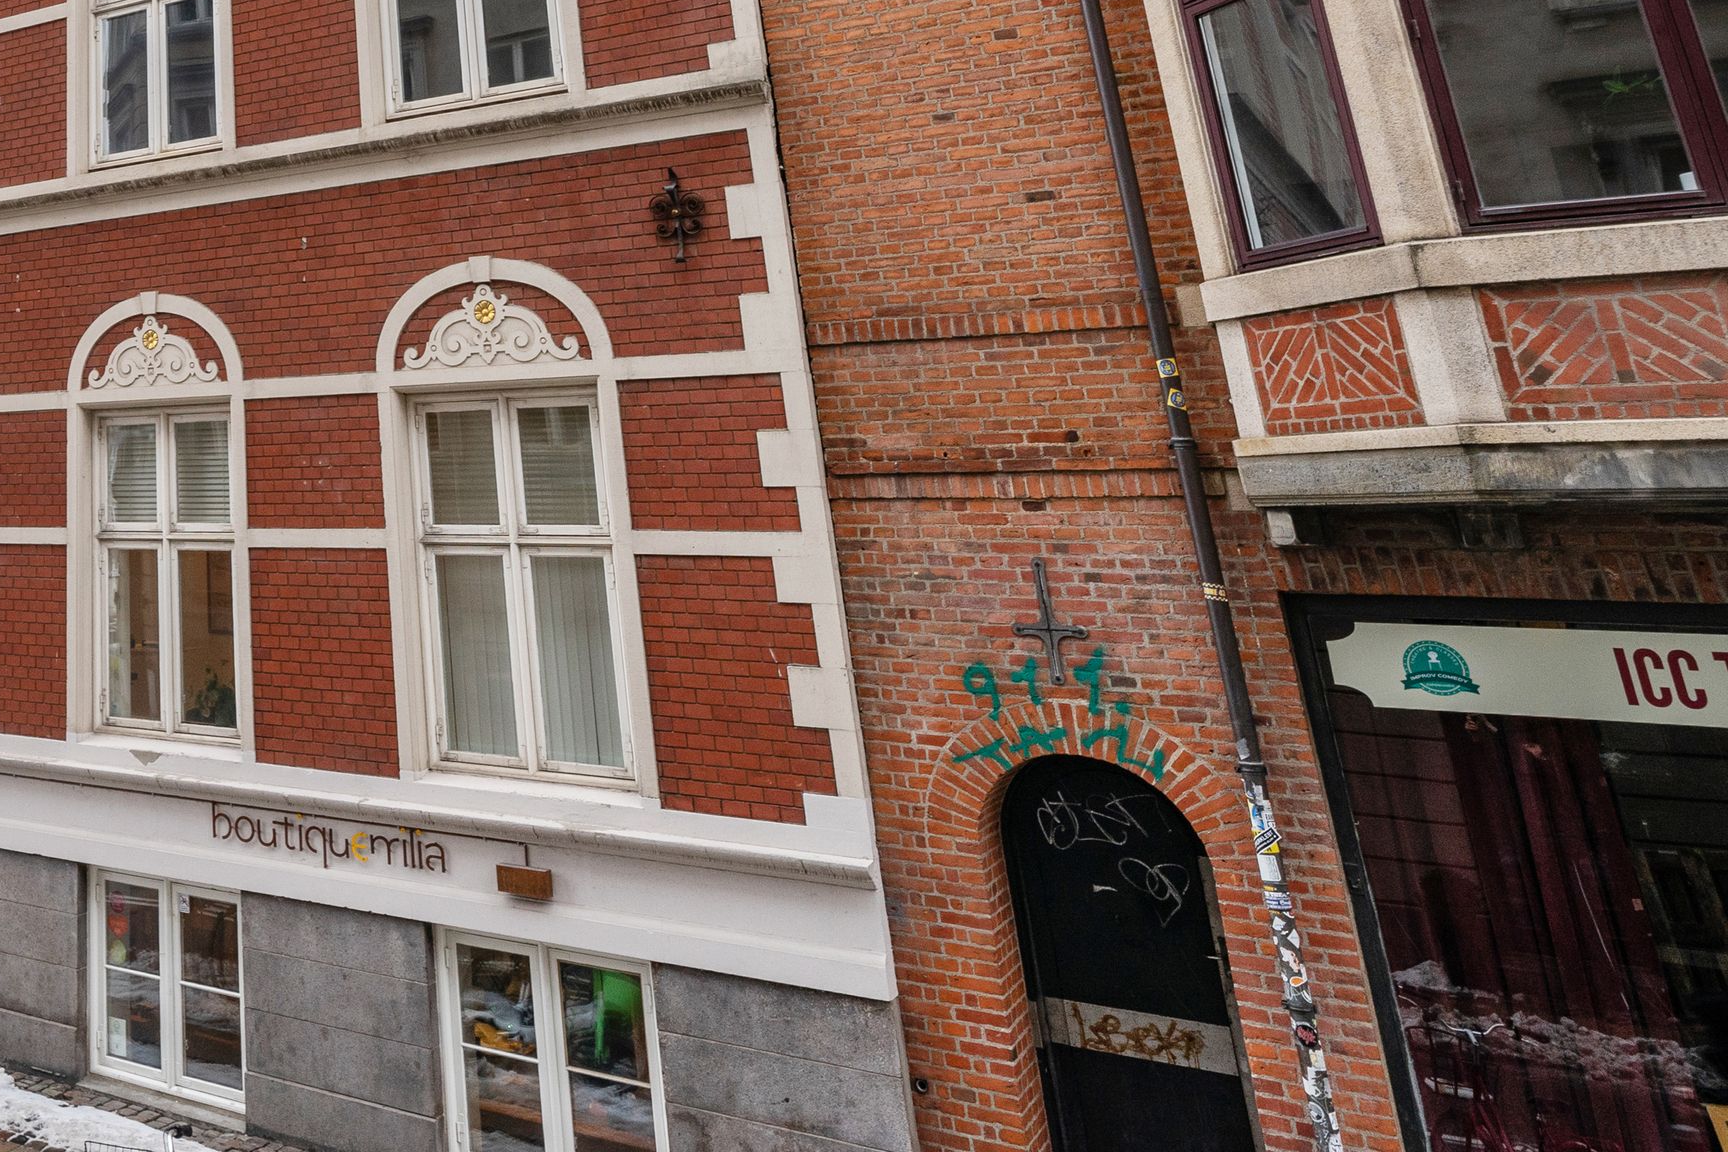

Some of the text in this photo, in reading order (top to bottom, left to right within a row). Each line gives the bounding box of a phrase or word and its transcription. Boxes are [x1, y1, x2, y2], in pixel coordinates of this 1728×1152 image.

[1410, 672, 1469, 684] IMPROV COMEDY
[1613, 647, 1708, 709] ICC
